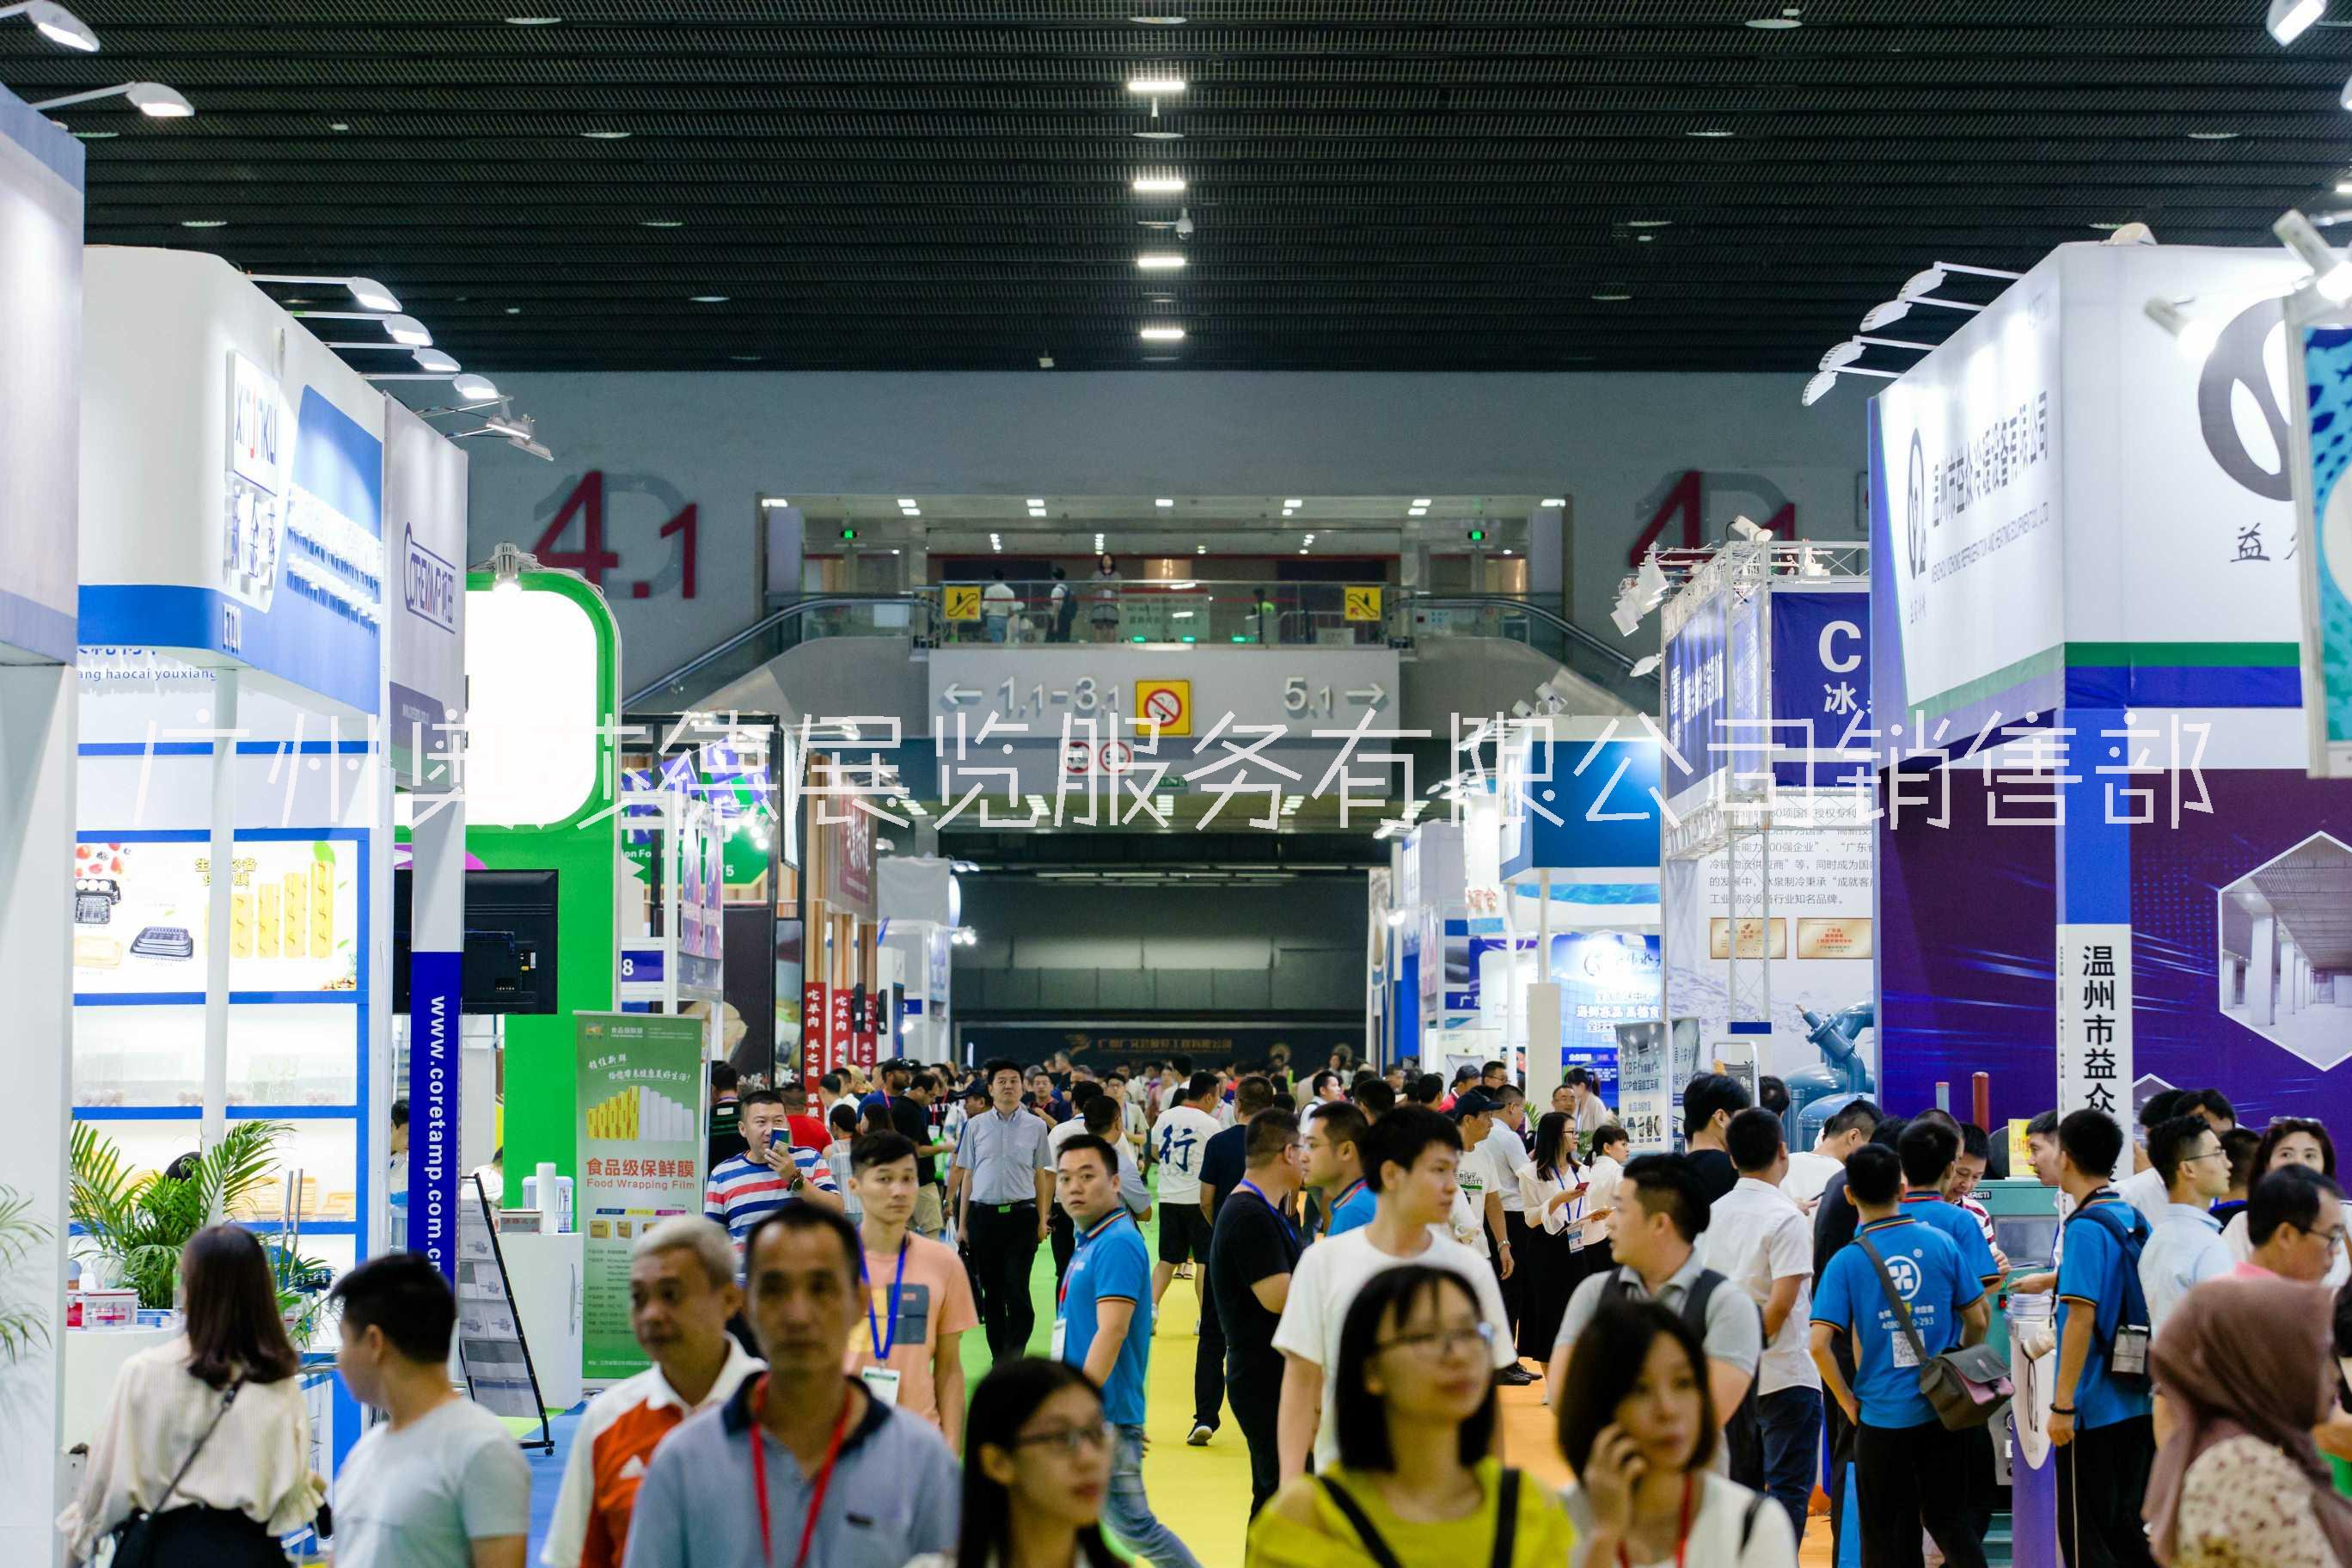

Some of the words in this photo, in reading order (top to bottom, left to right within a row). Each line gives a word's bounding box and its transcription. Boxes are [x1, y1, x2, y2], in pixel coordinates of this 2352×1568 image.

[530, 469, 698, 600] 4.1
[106, 668, 150, 679] haocai
[1283, 677, 1332, 712] 5.1
[1159, 1124, 1198, 1173] 行
[586, 1157, 695, 1178] 食品级保鲜膜
[586, 1179, 613, 1188] Food
[616, 1179, 668, 1191] Wrapping
[672, 1180, 695, 1190] Film
